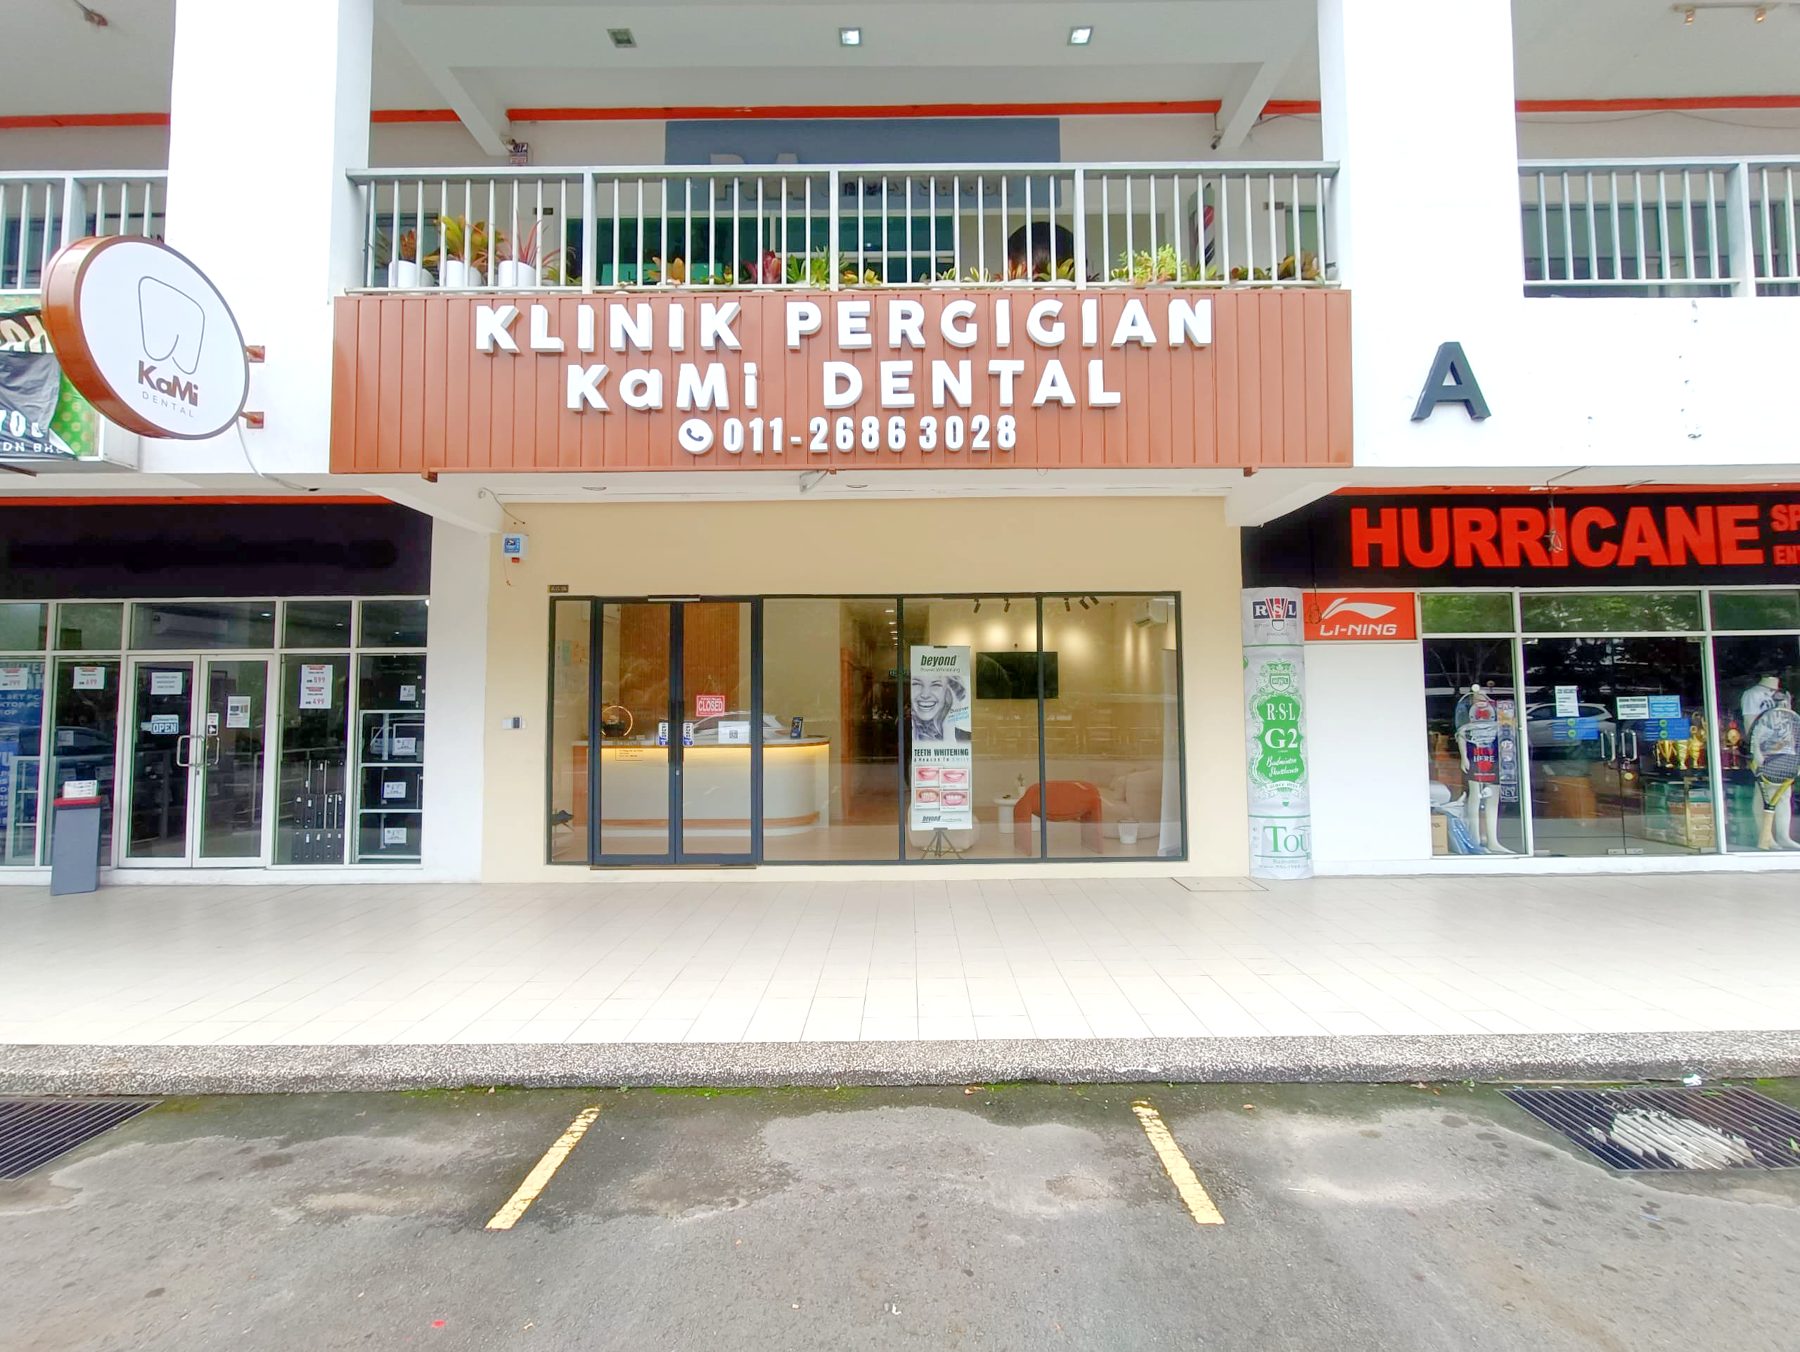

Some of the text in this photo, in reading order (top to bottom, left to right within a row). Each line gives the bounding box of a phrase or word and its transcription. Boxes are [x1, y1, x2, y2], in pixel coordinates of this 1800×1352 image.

[476, 299, 1212, 353] KLINIK PERGIGIAN
[138, 360, 199, 407] KaMi
[567, 359, 1121, 411] KaMi DENTAL
[1410, 341, 1492, 421] A
[142, 391, 195, 418] DENTAL
[1350, 504, 1764, 568] HURRICANE
[1320, 624, 1397, 636] LI-NING
[921, 655, 957, 667] beyond
[698, 700, 723, 711] CLOSED
[152, 722, 177, 733] OPEN
[1264, 727, 1299, 749] G2
[914, 748, 969, 756] TEETH WHITENING
